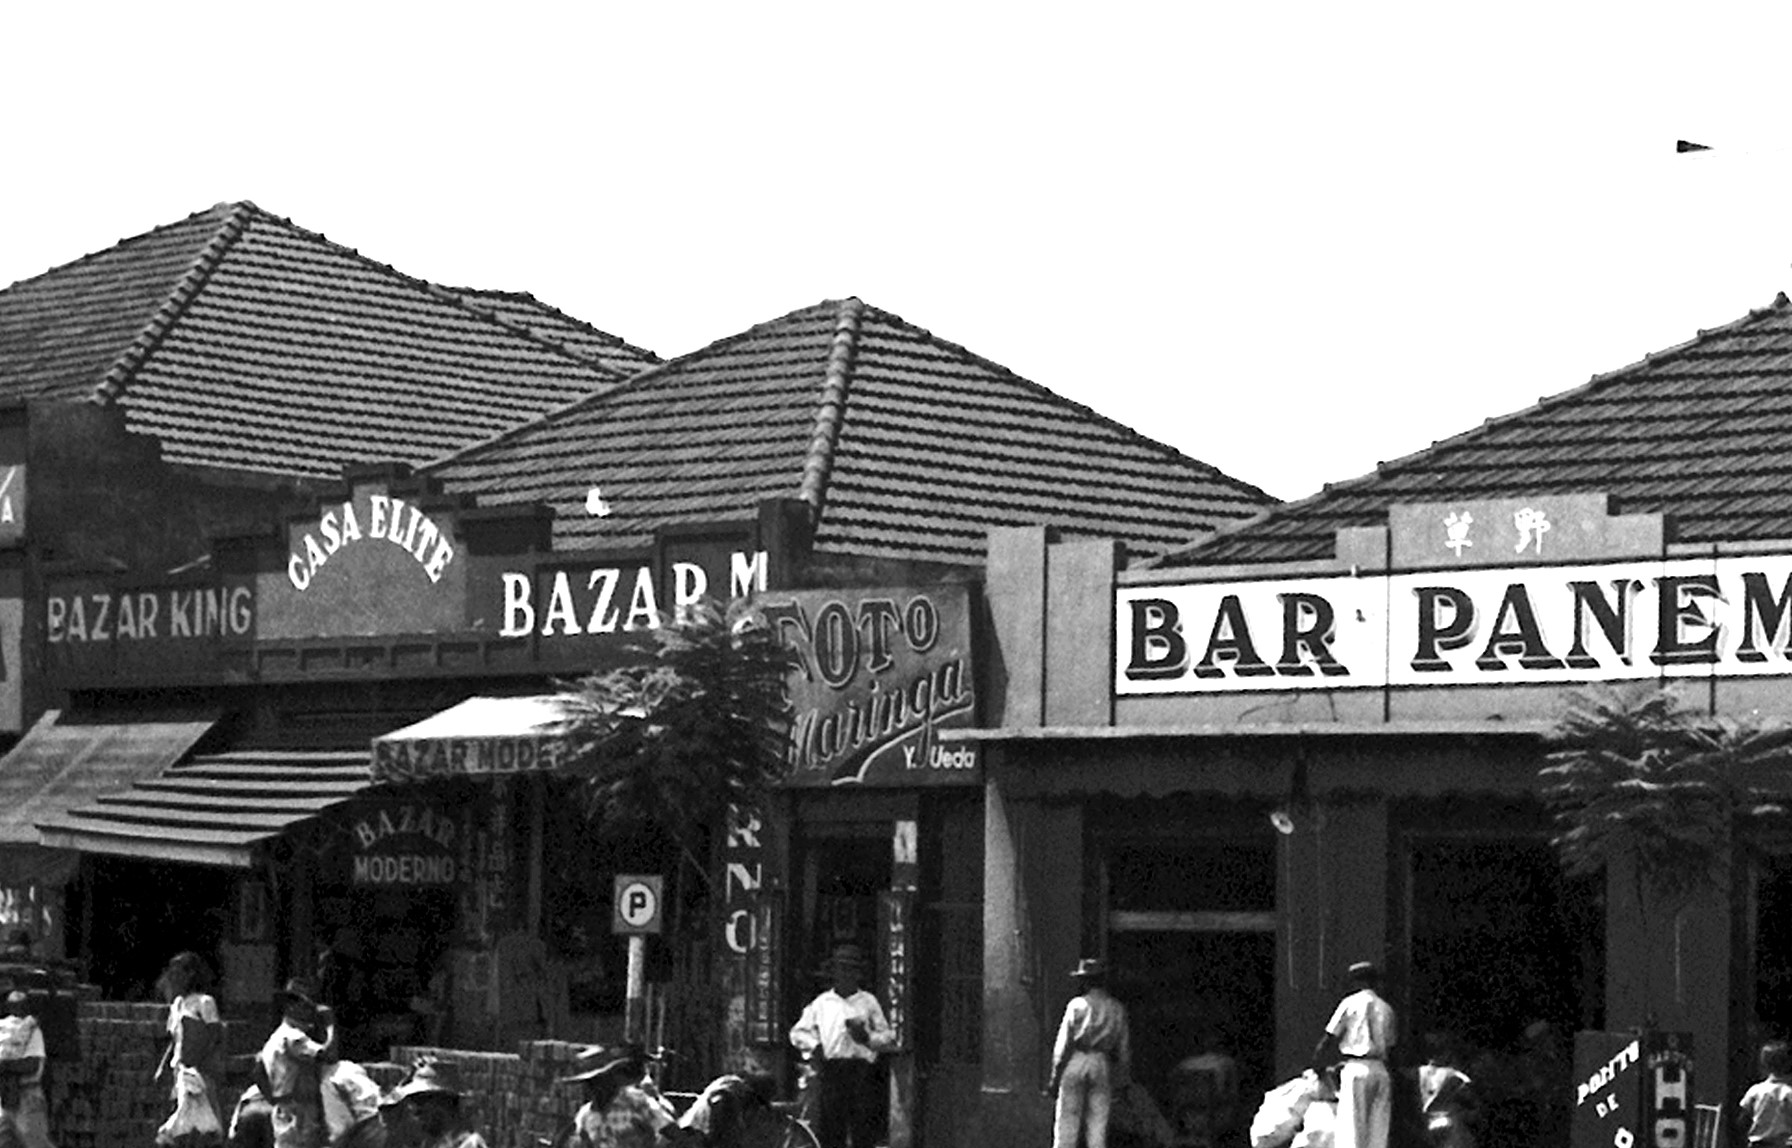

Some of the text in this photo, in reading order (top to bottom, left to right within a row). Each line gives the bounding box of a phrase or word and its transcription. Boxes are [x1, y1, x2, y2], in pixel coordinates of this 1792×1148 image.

[287, 495, 456, 591] CASA ELITE
[48, 586, 252, 642] BAZAR KING
[500, 562, 708, 637] BAZAR
[1125, 593, 1350, 680] BAR
[930, 746, 975, 769] Ueda
[356, 805, 455, 849] BAZAR
[354, 855, 456, 884] MODERNO
[628, 891, 647, 917] P
[1596, 1093, 1619, 1118] DE
